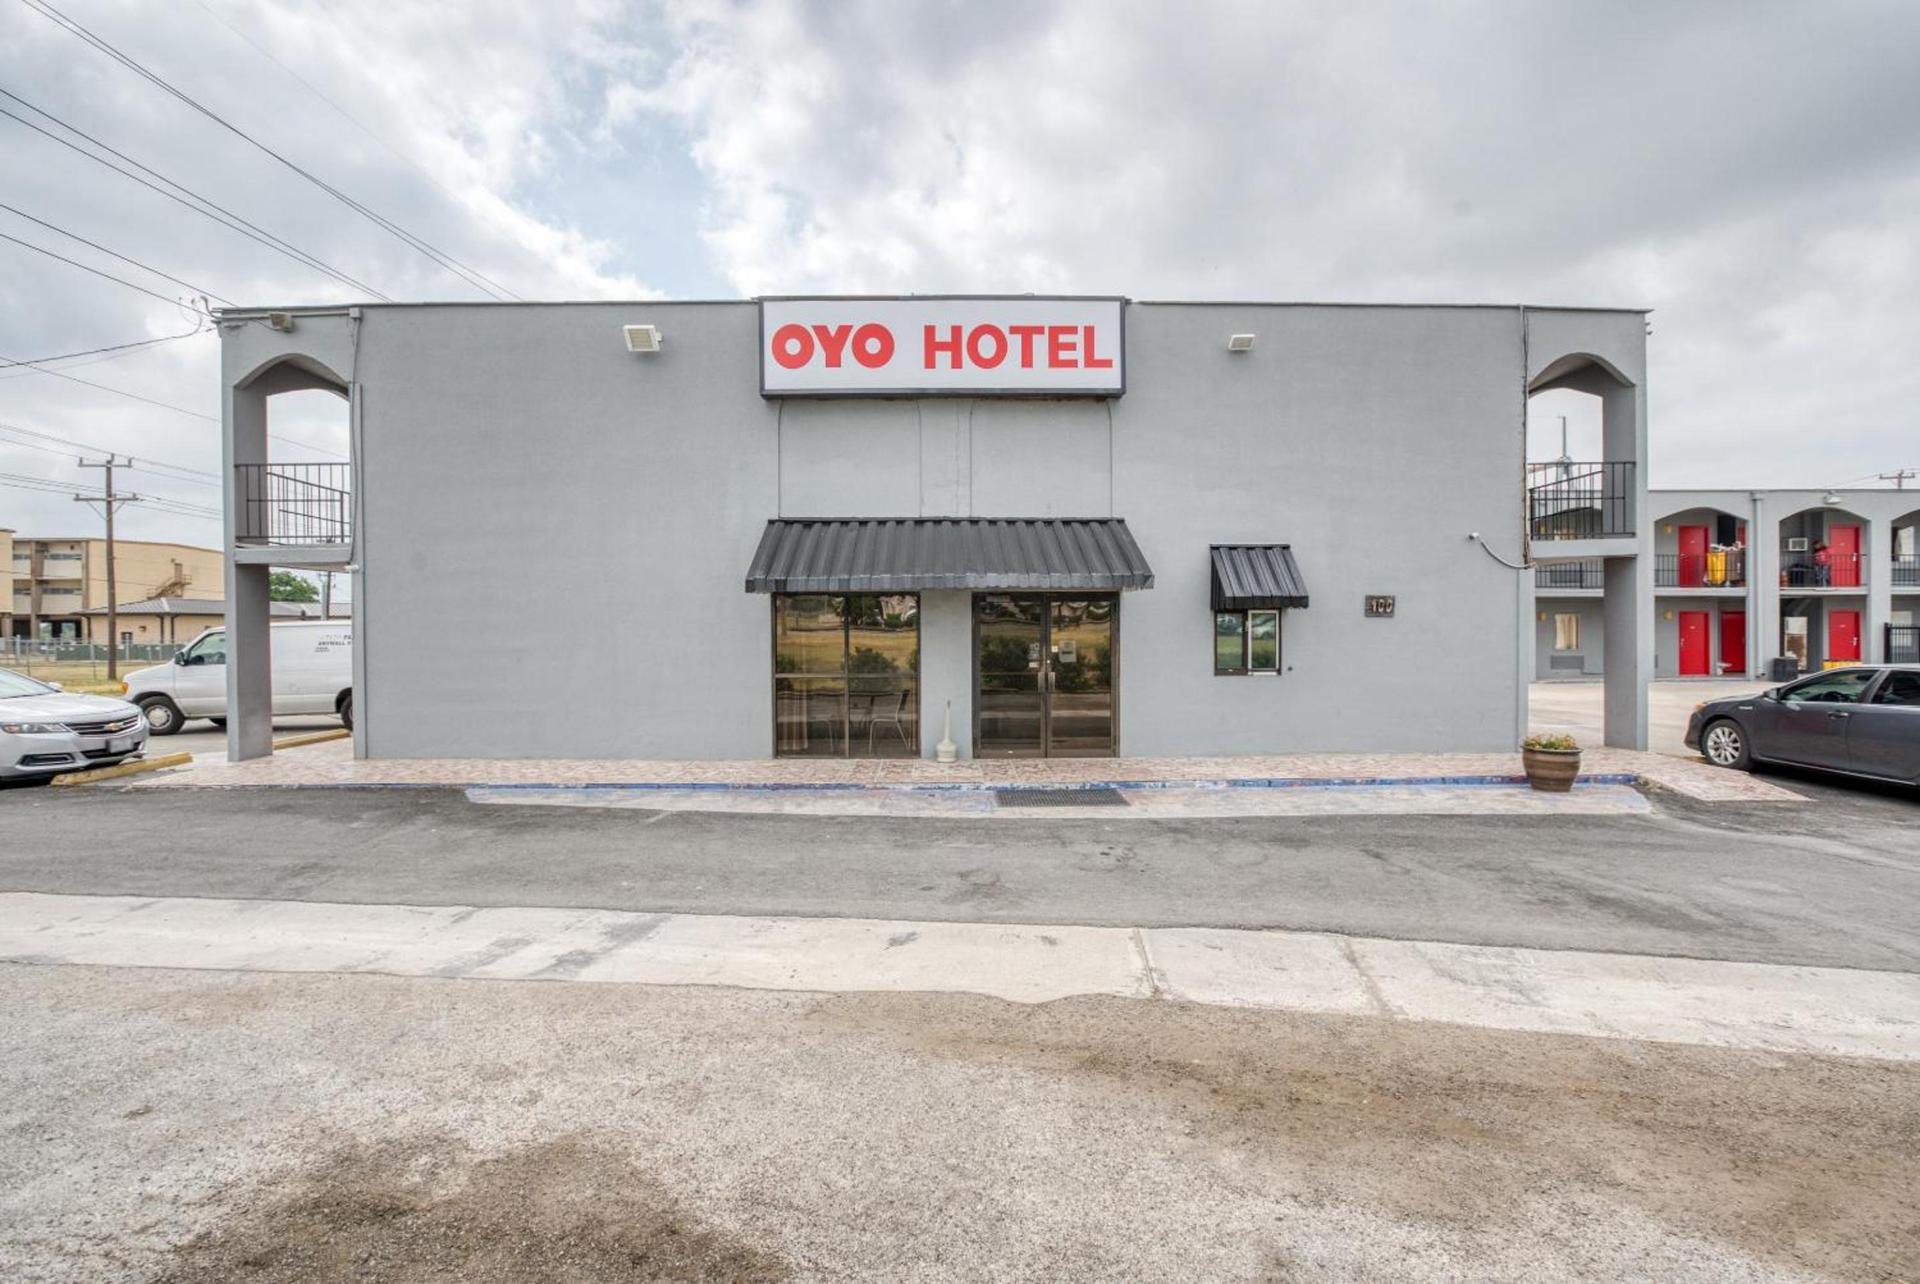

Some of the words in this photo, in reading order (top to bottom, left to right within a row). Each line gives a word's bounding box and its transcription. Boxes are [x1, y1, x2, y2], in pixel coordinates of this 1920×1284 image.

[771, 323, 895, 369] OYO
[923, 324, 1113, 369] HOTEL
[1372, 599, 1393, 612] 100
